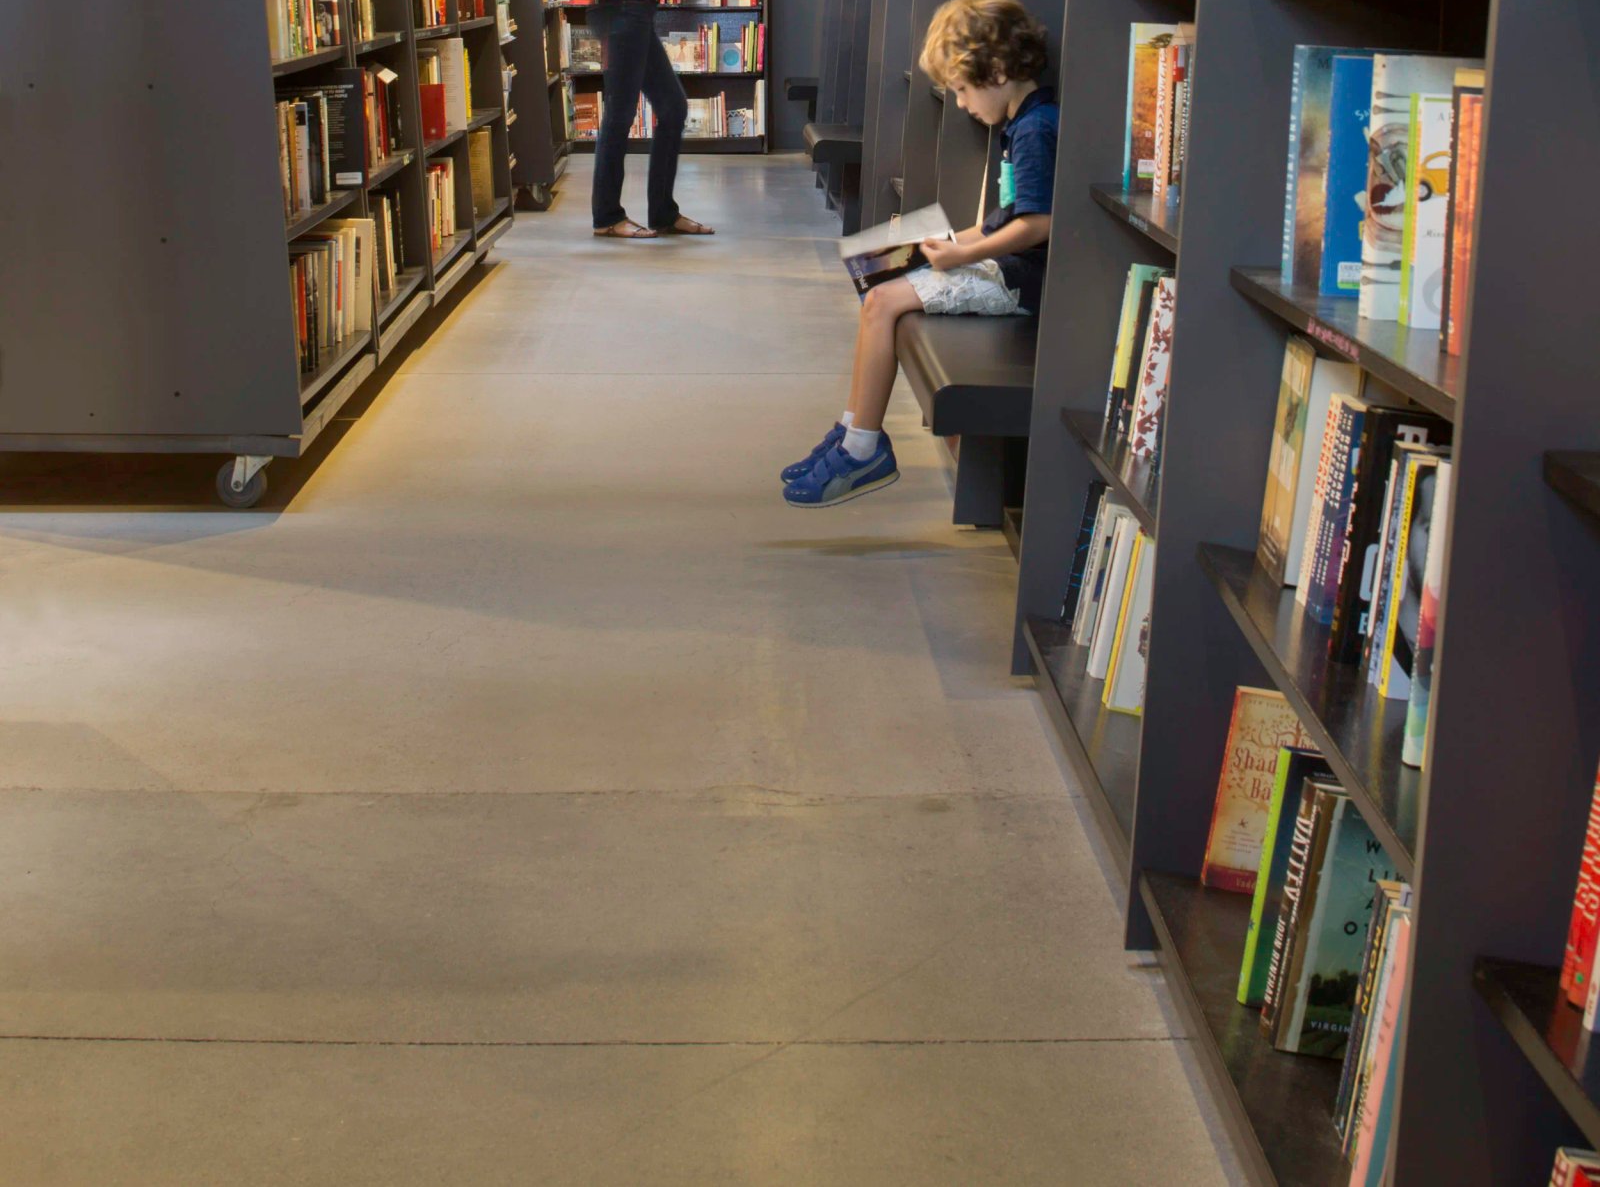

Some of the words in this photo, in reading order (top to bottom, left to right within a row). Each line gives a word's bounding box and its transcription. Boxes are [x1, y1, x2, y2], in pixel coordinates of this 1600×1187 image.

[1289, 114, 1297, 142] AND
[1334, 435, 1351, 509] REVENANT
[1233, 747, 1278, 774] Shad
[1274, 918, 1287, 950] JOHN
[1310, 1020, 1351, 1034] VIRGIN
